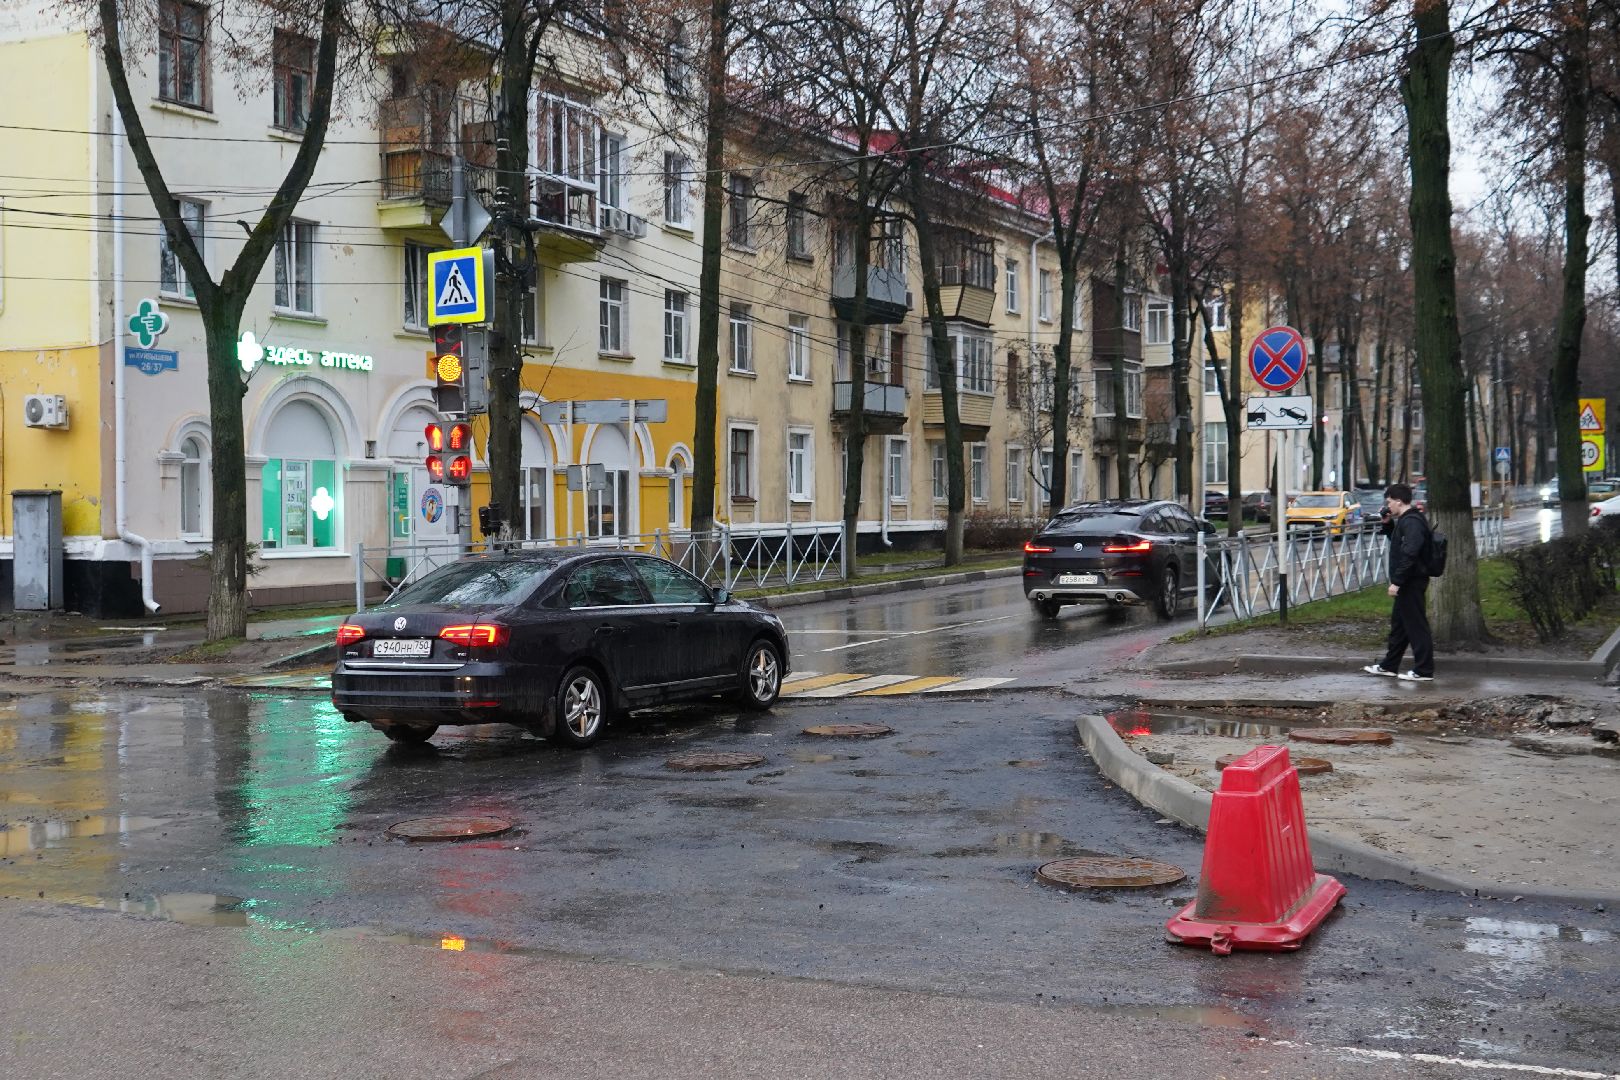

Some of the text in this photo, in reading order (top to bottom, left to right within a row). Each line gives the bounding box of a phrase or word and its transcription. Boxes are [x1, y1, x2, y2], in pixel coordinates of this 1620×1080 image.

[266, 346, 372, 371] здесь аптека
[1581, 448, 1595, 459] 40
[414, 640, 429, 650] 750
